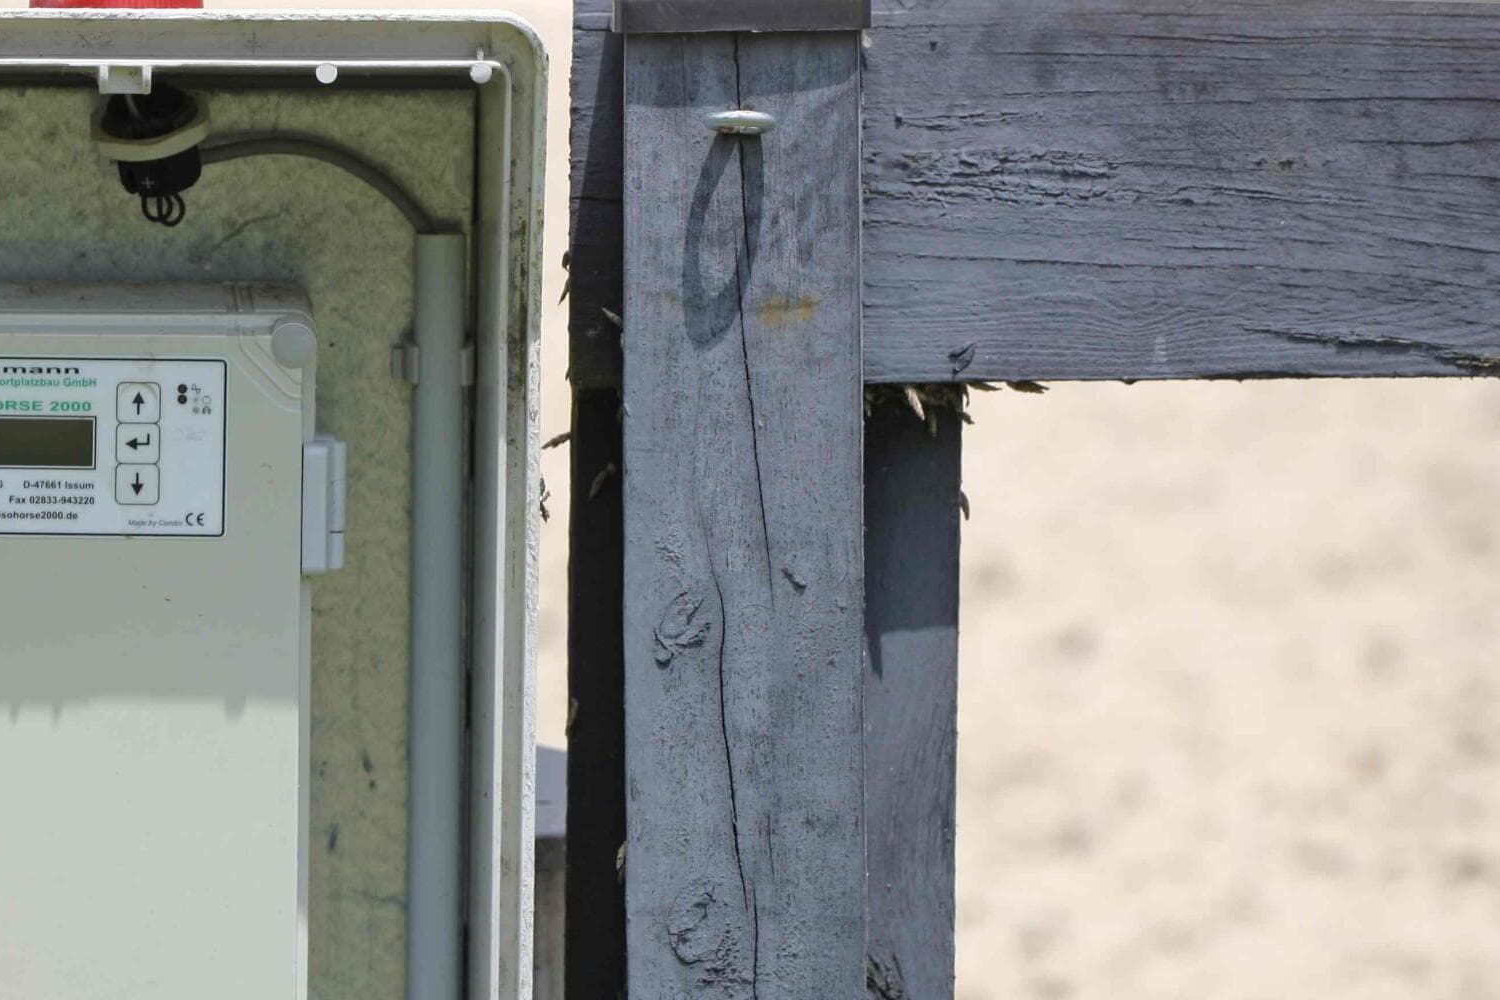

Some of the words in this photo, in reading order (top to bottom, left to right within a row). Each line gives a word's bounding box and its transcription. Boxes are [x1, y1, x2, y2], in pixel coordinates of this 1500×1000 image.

[63, 377, 97, 387] GmbH
[50, 401, 92, 412] 2000
[23, 480, 62, 489] D-47661
[64, 480, 95, 489] Issum
[9, 496, 26, 504] Fax
[29, 496, 95, 505] 02833-943220
